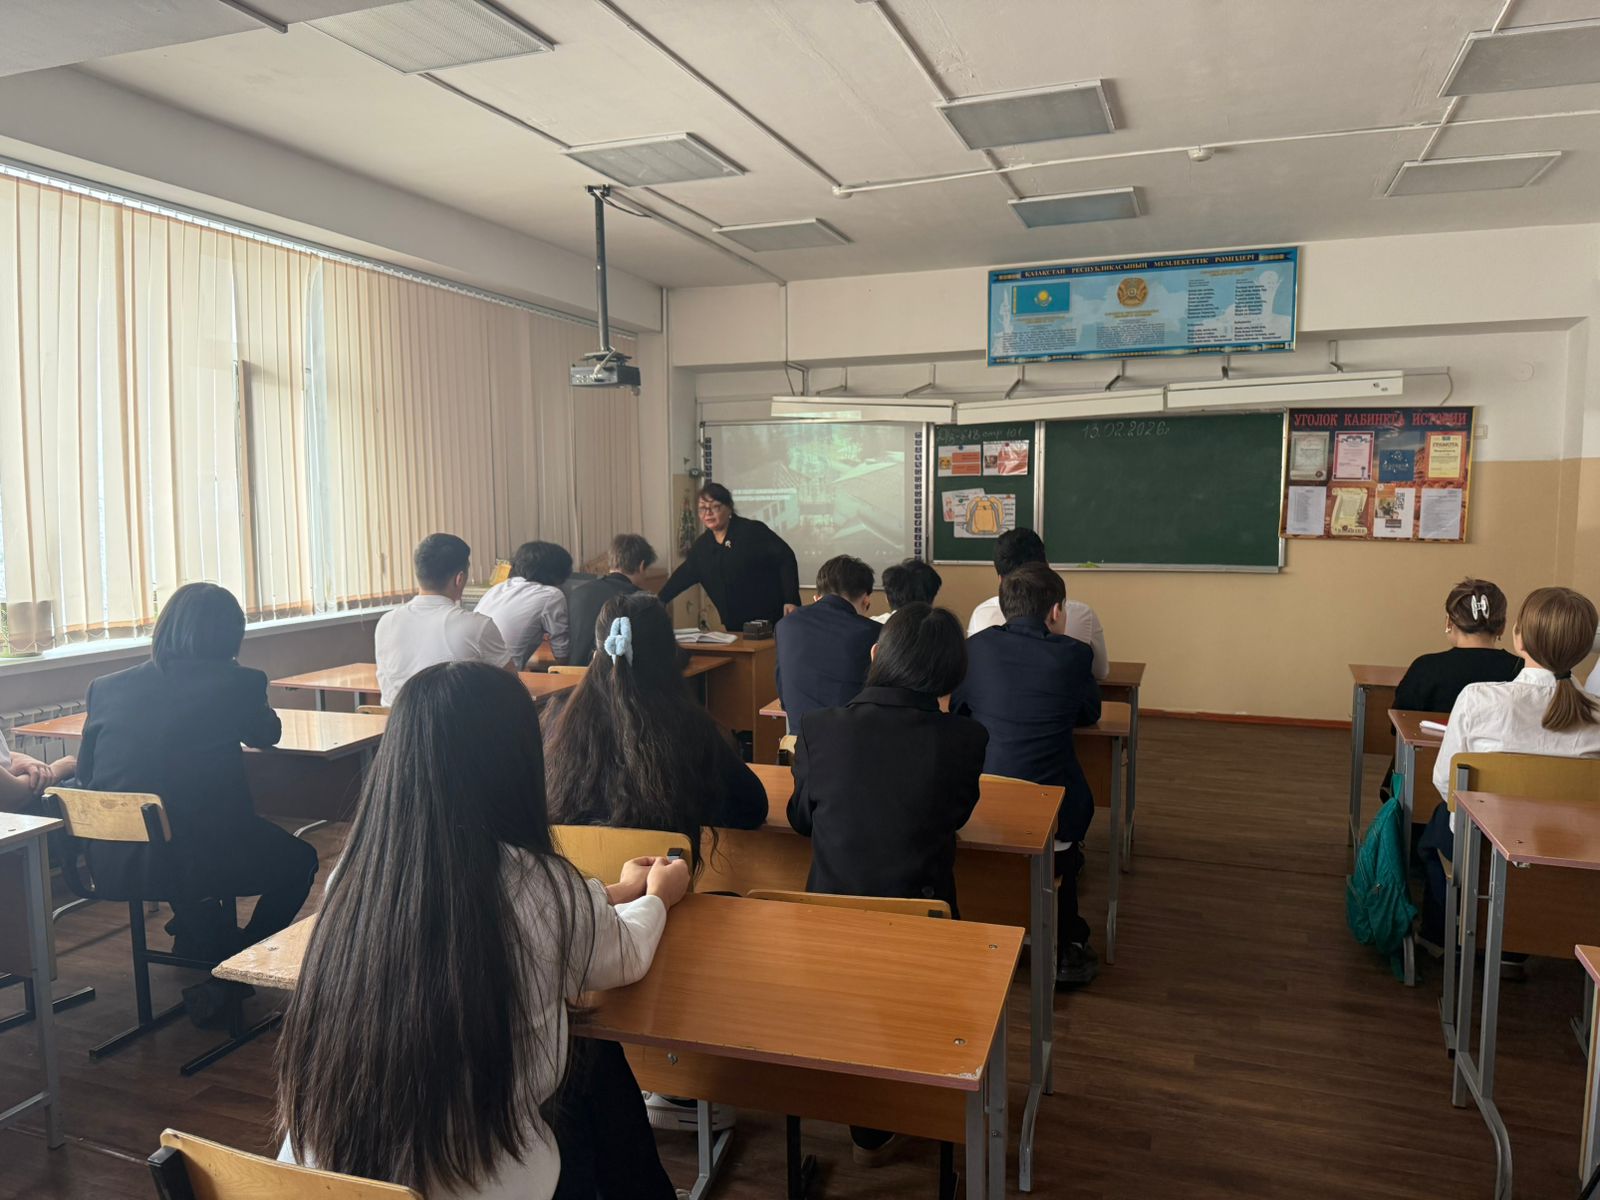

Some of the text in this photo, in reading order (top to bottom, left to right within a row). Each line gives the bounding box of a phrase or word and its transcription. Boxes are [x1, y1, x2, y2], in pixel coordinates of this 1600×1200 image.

[1294, 412, 1467, 426] УГОЛОК КАБИНЕТА ИСТОРИИ
